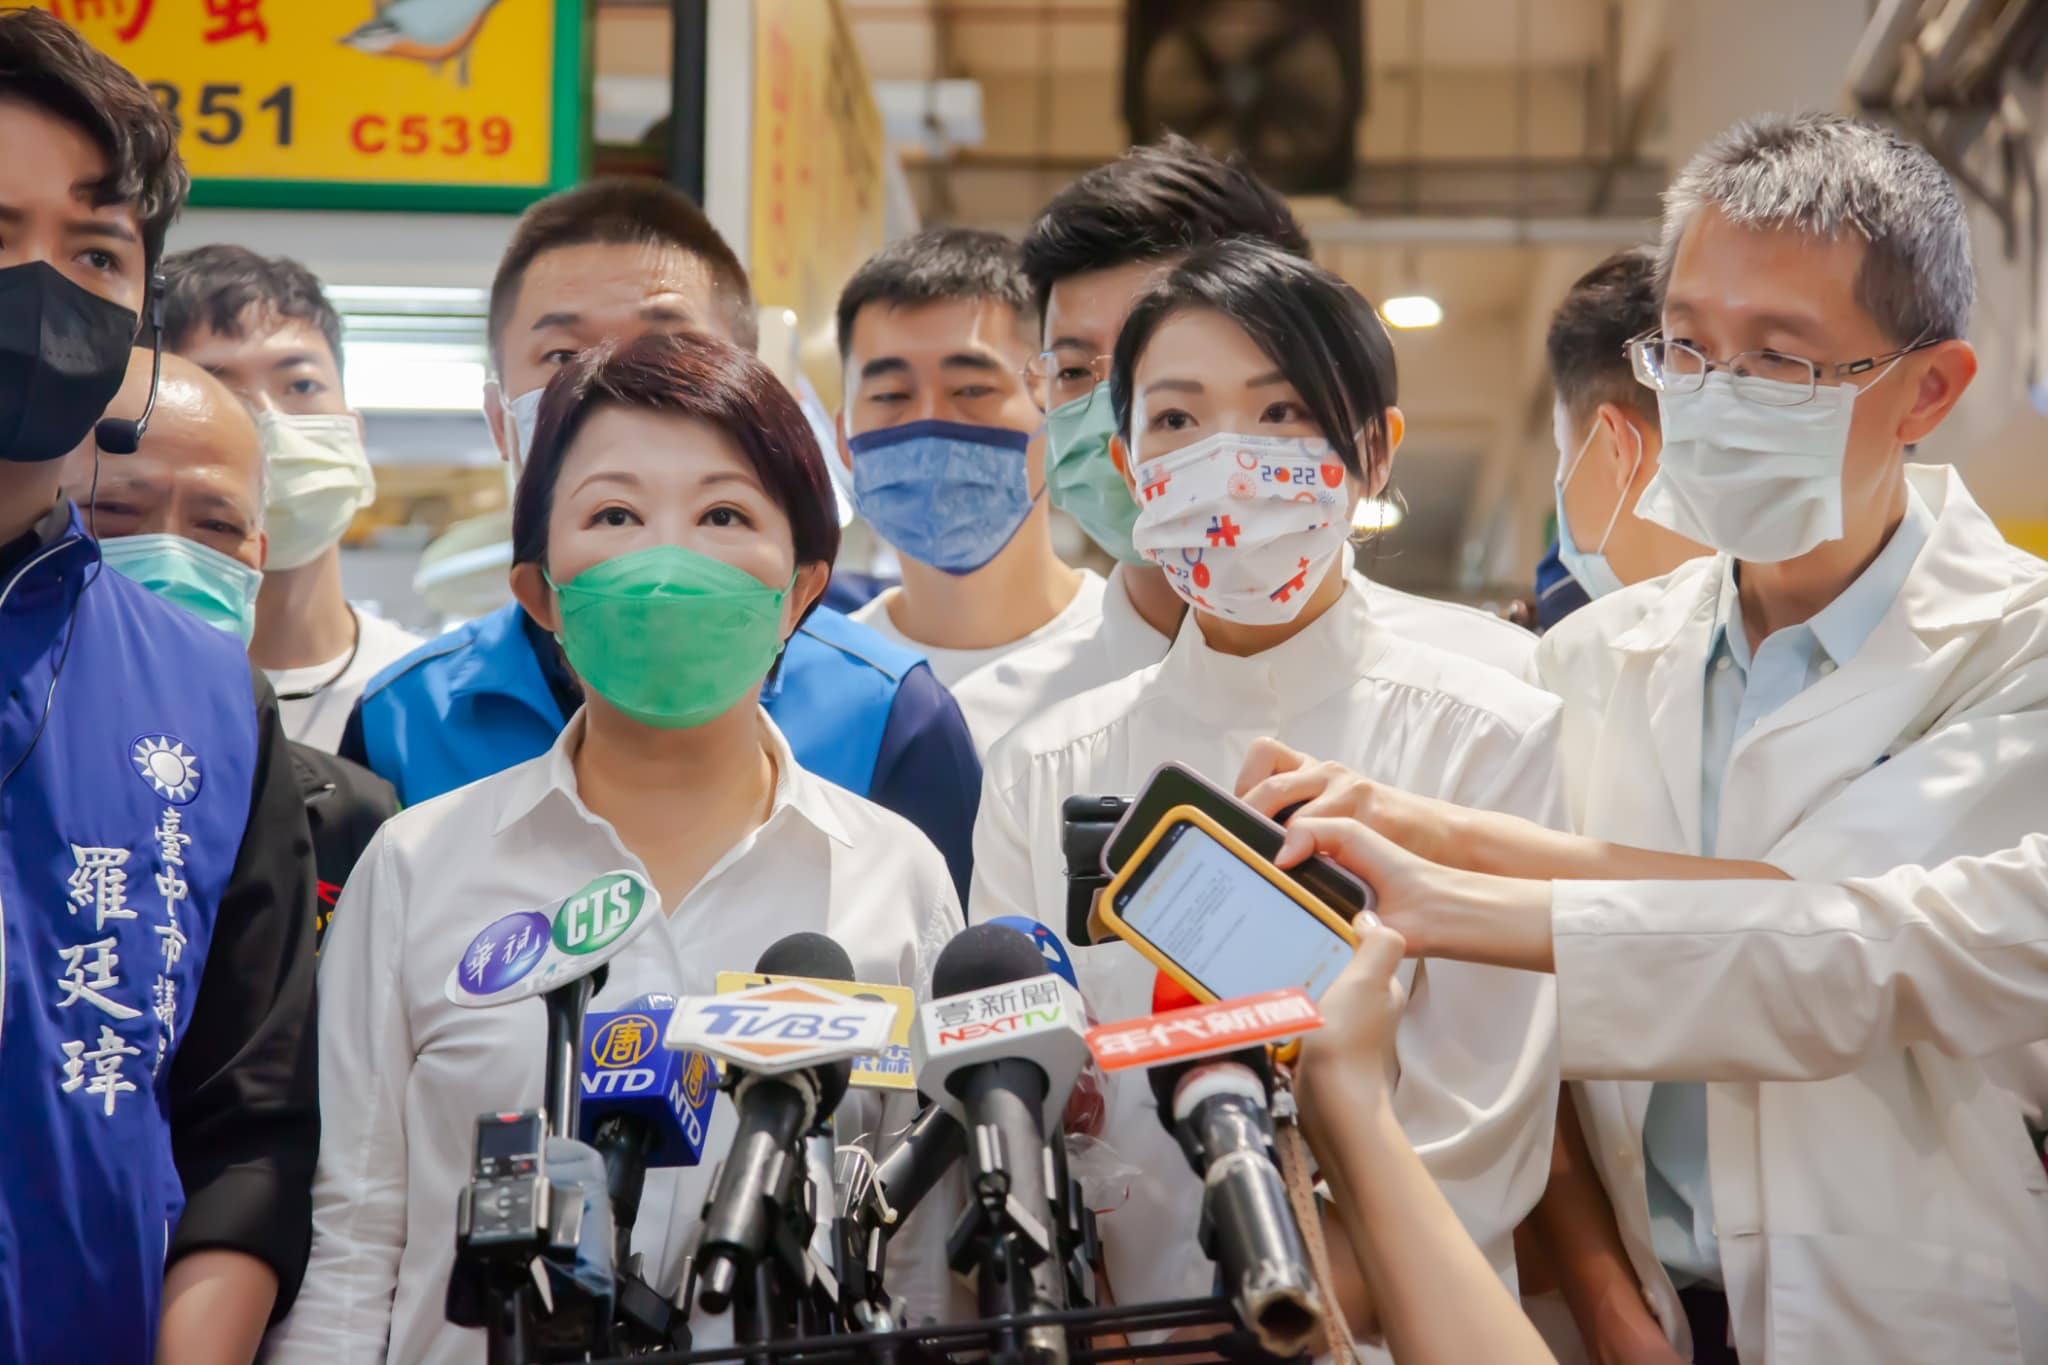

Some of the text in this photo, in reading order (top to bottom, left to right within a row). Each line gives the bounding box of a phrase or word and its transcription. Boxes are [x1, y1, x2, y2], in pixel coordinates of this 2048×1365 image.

[351, 114, 513, 156] C539
[566, 877, 632, 947] CTS
[56, 842, 143, 1116] 羅廷瑋
[466, 924, 542, 989] 華視
[699, 1003, 867, 1041] TVBS
[936, 979, 1061, 1030] 壹新聞
[1094, 994, 1316, 1057] 年代新聞
[581, 1068, 656, 1094] NTD
[669, 1079, 702, 1147] NTD
